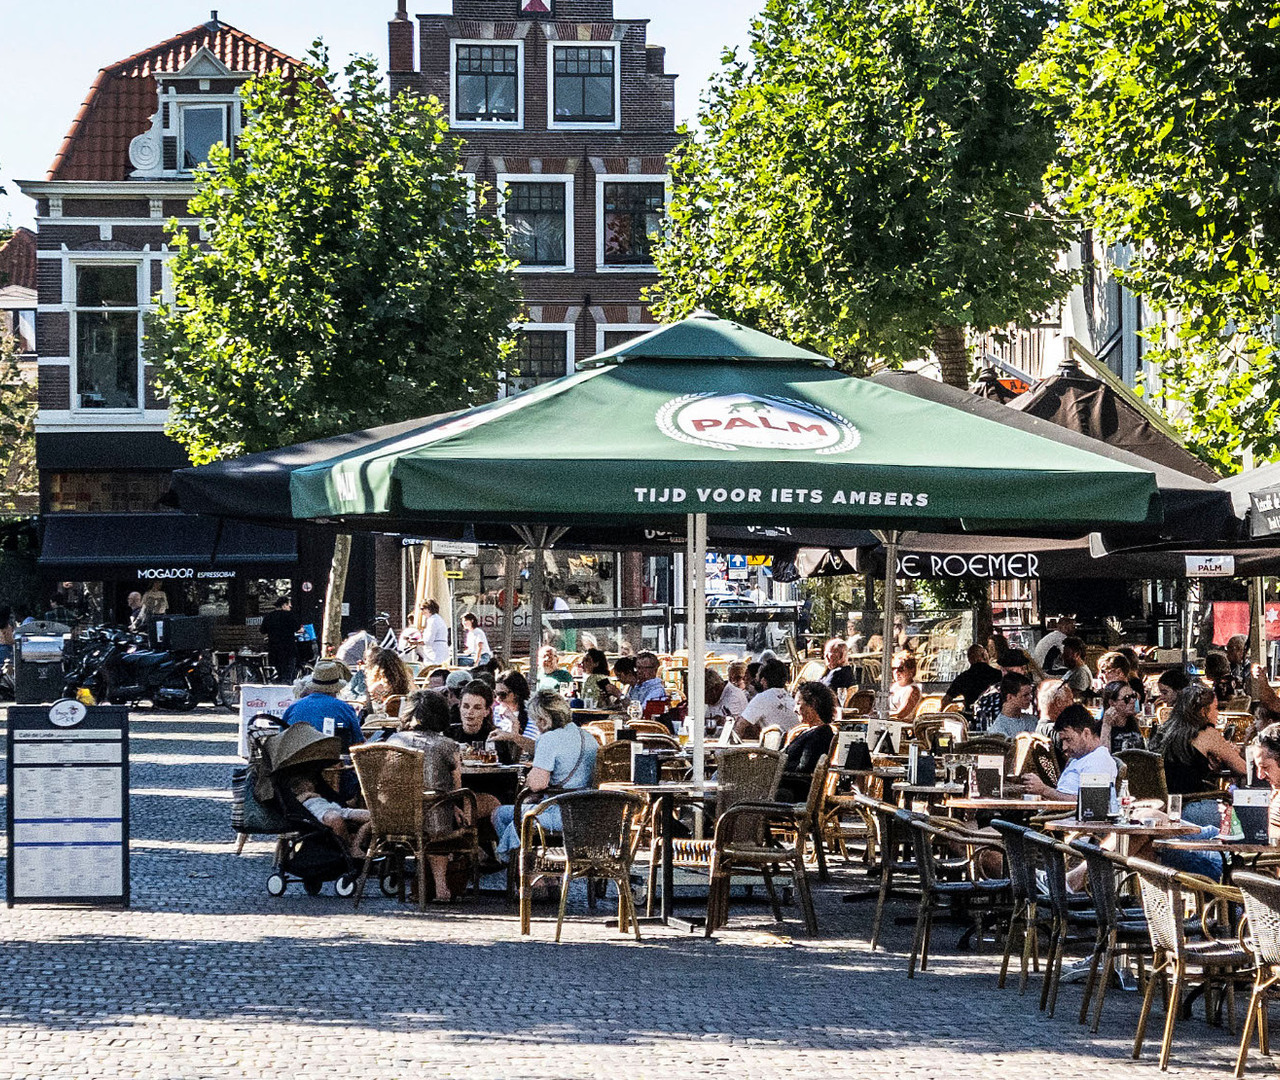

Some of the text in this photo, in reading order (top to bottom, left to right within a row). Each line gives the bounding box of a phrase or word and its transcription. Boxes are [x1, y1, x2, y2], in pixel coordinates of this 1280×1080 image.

[691, 416, 828, 436] PALM
[634, 488, 929, 506] TIJD VOOR IETS AMBERS
[137, 568, 236, 579] MOGADOR ESPRESSOBAR
[931, 554, 1039, 577] ROEMER
